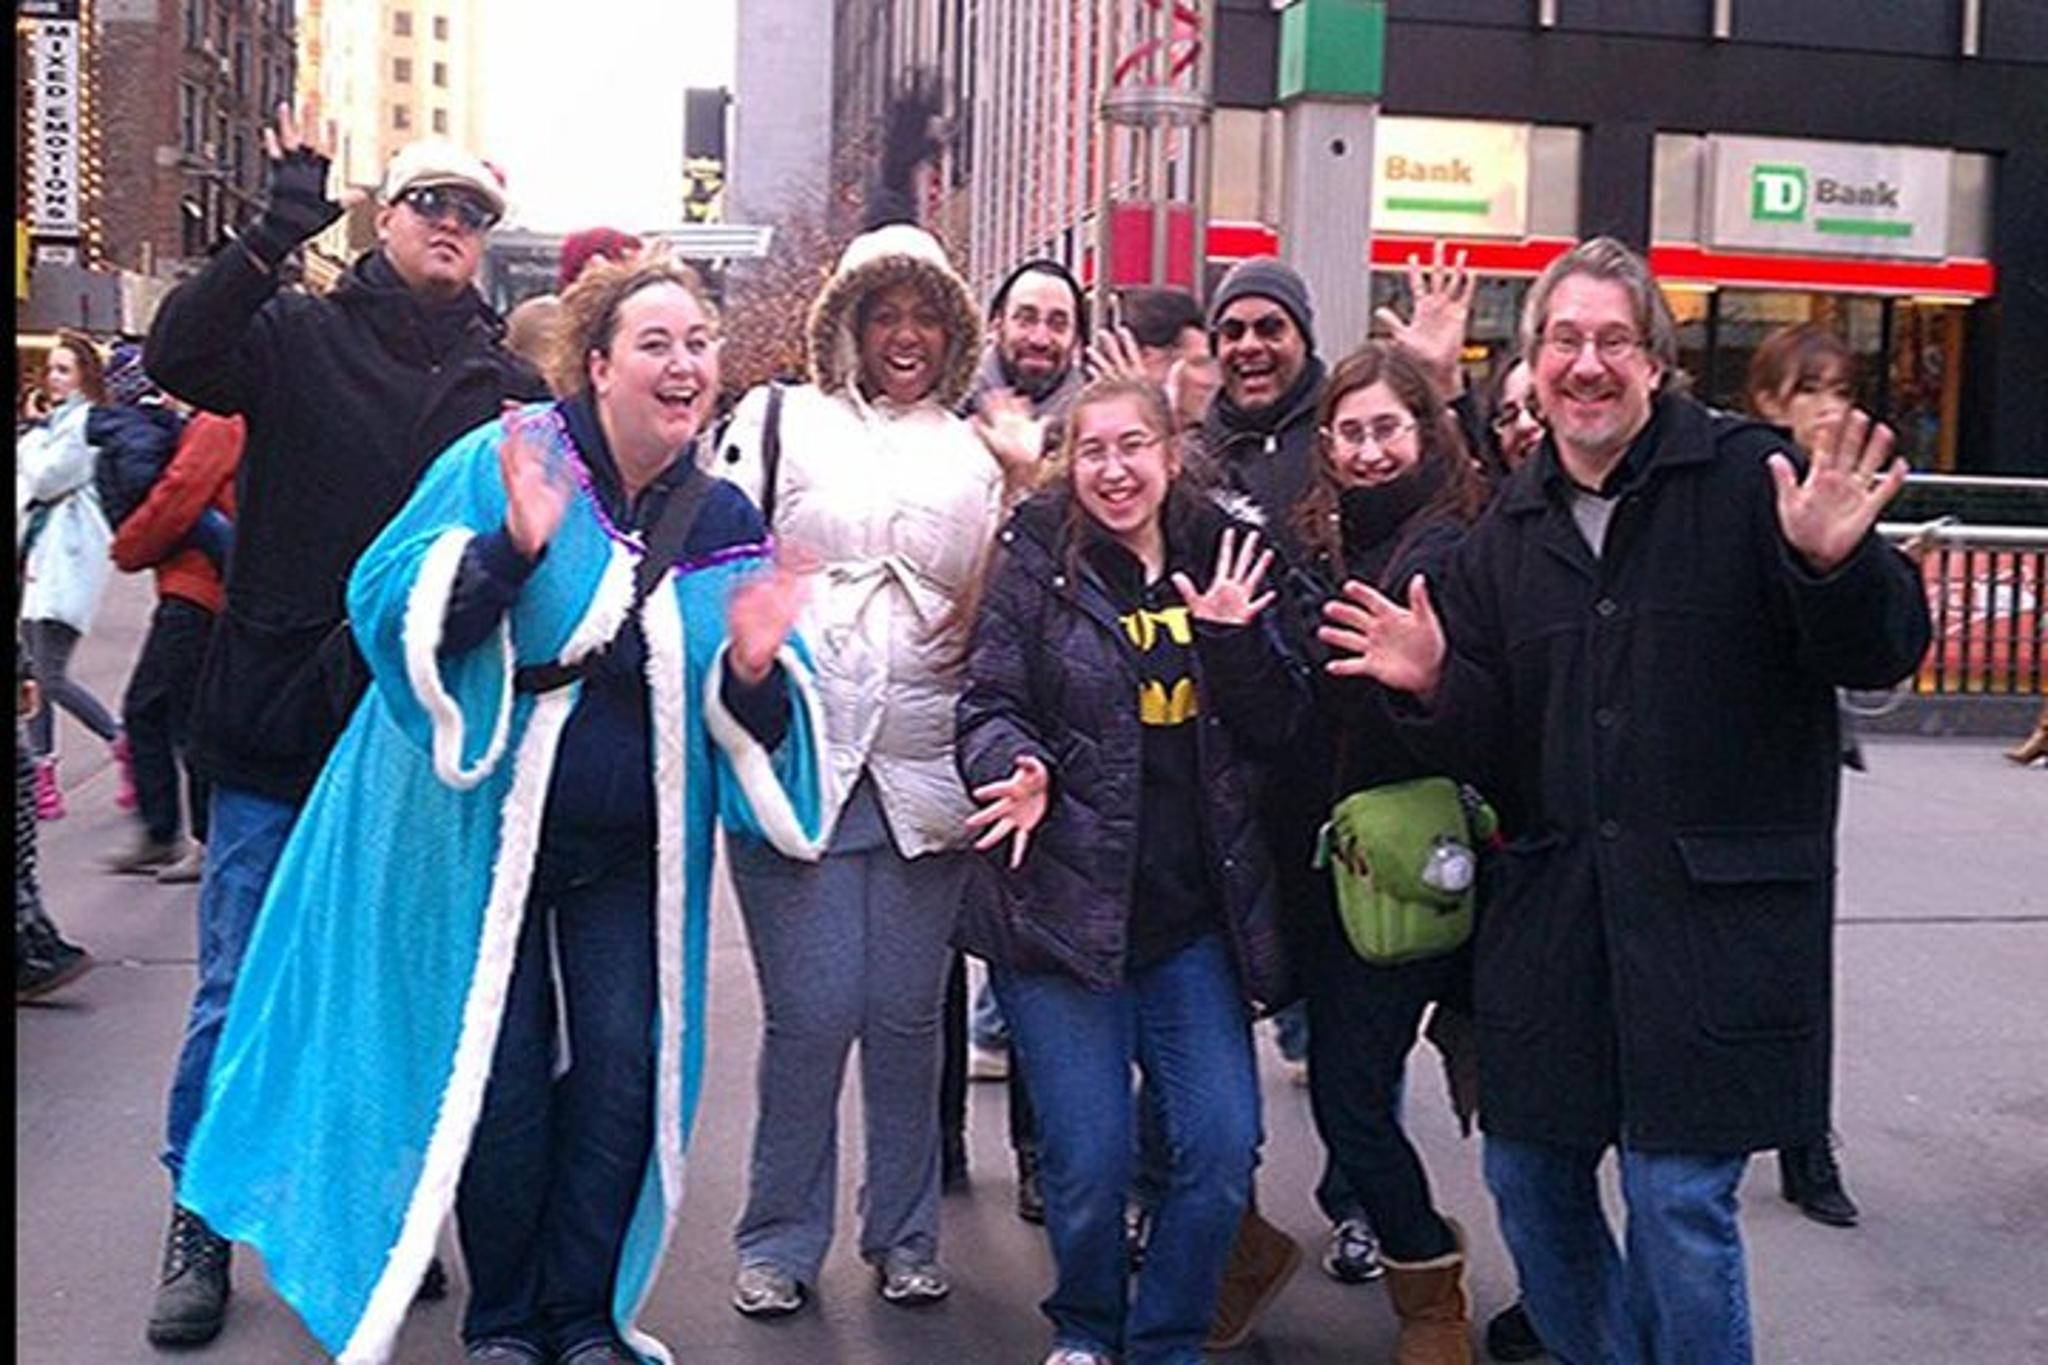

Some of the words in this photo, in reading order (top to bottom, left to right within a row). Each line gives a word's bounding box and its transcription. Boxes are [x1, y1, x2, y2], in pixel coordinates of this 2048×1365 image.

[43, 25, 70, 98] MIXED
[43, 108, 70, 219] EMOTIONS
[1385, 156, 1472, 184] Bank
[1756, 173, 1801, 212] TD
[1816, 178, 1898, 207] Bank
